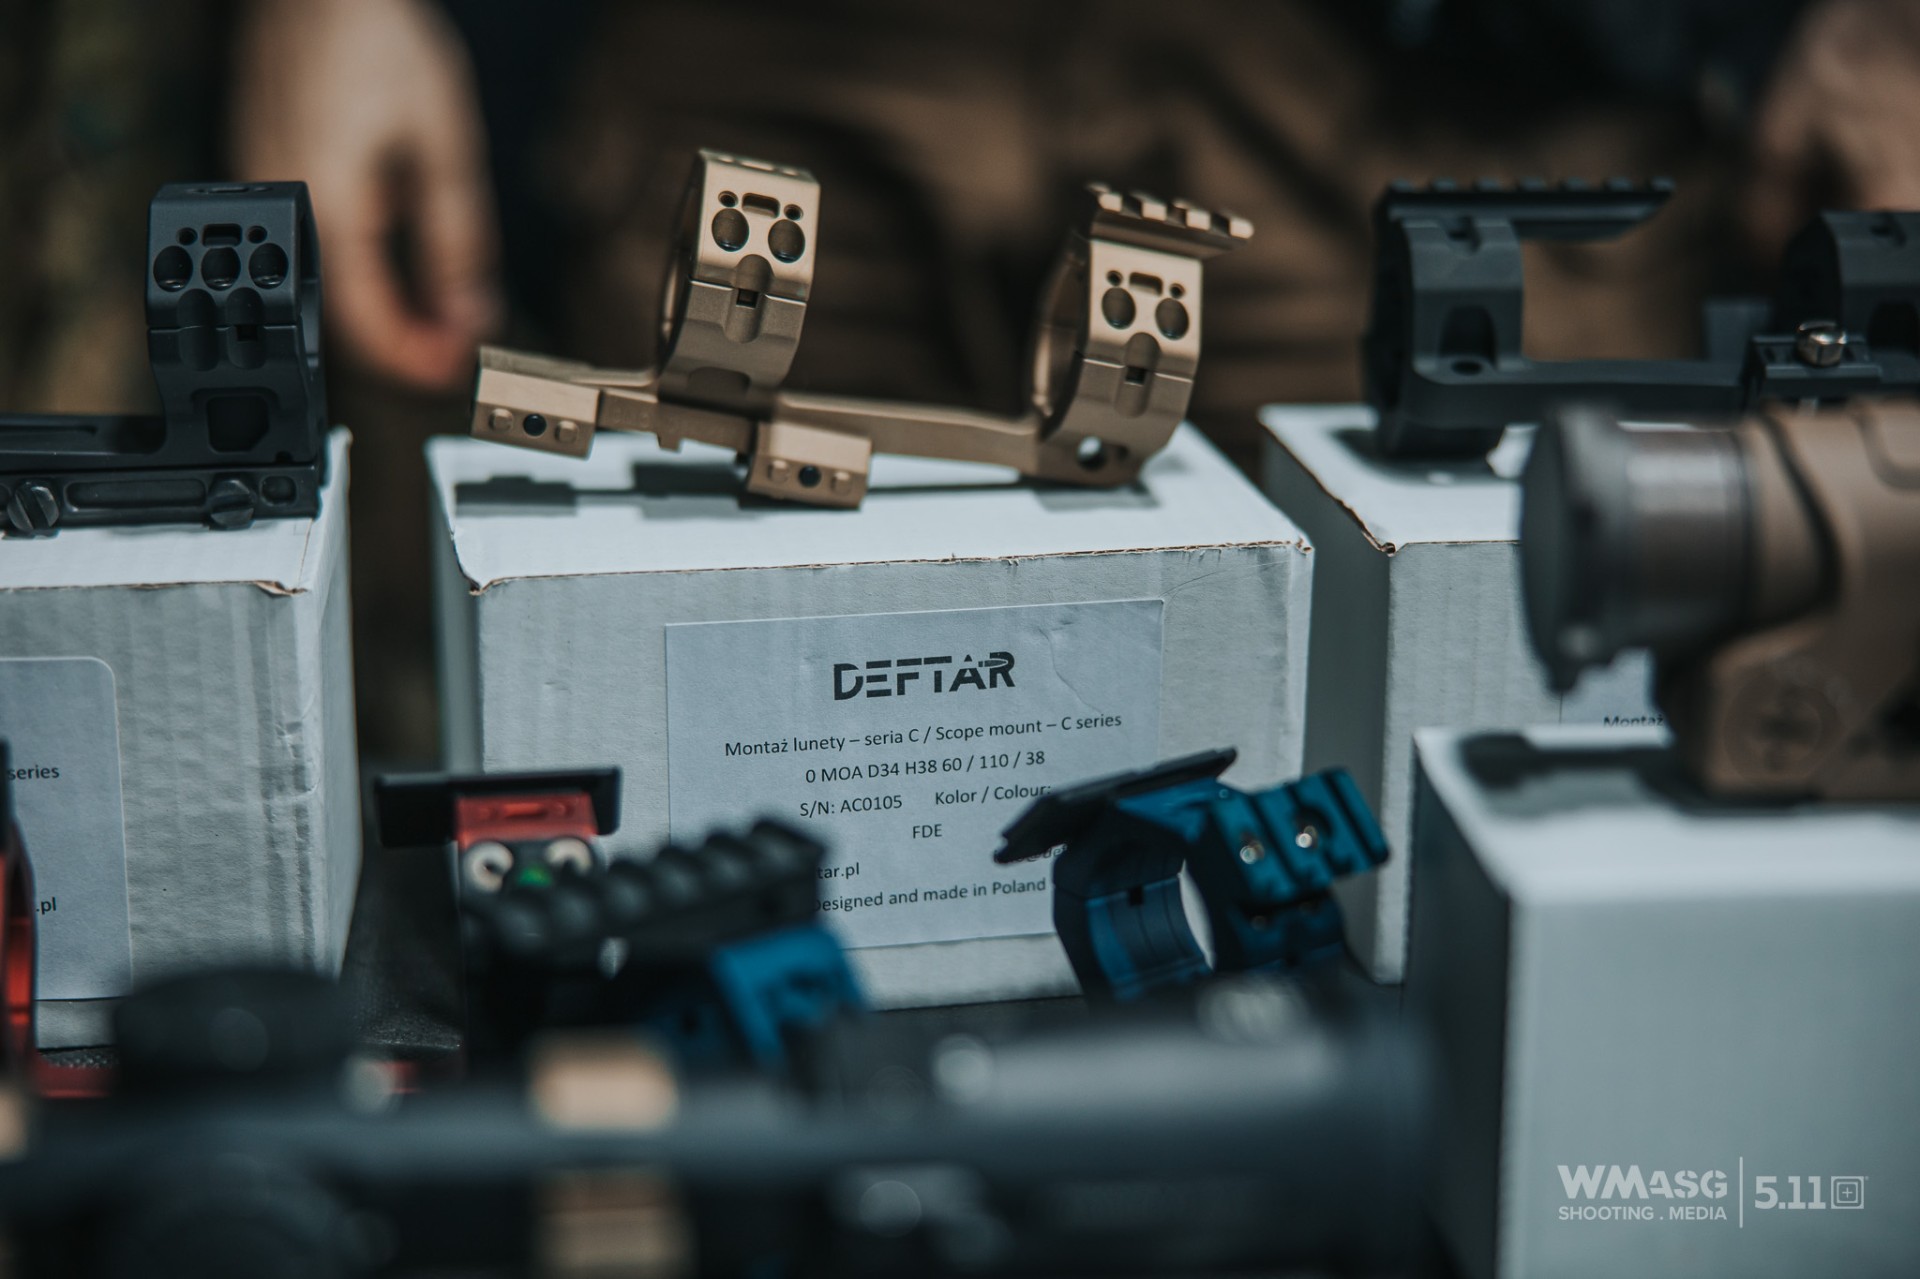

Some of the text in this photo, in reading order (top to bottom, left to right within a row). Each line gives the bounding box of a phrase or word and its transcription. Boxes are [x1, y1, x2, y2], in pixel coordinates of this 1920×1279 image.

[833, 651, 1016, 701] DEFTAR
[725, 738, 788, 757] Montaż
[793, 737, 846, 752] lunety
[864, 730, 903, 746] seria
[908, 728, 920, 743] C
[923, 726, 932, 744] /
[936, 726, 984, 742] Scope
[989, 720, 1042, 736] mount
[1061, 716, 1072, 731] C
[1076, 714, 1122, 730] series
[6, 764, 60, 780] series
[821, 765, 863, 782] MOA
[868, 762, 900, 778] D34
[905, 759, 938, 775] H38
[942, 757, 962, 772] 60
[966, 755, 975, 772] /
[979, 753, 1009, 770] 110
[1012, 751, 1021, 769] /
[1025, 751, 1045, 766] 38
[800, 795, 903, 819] S/N: AC0105
[935, 789, 977, 805] Kolor
[981, 786, 989, 804] /
[912, 823, 943, 839] FDE
[816, 861, 860, 879] tar.pl
[889, 888, 918, 905] and
[923, 884, 968, 902] made
[973, 883, 987, 897] in
[992, 877, 1046, 895] Poland
